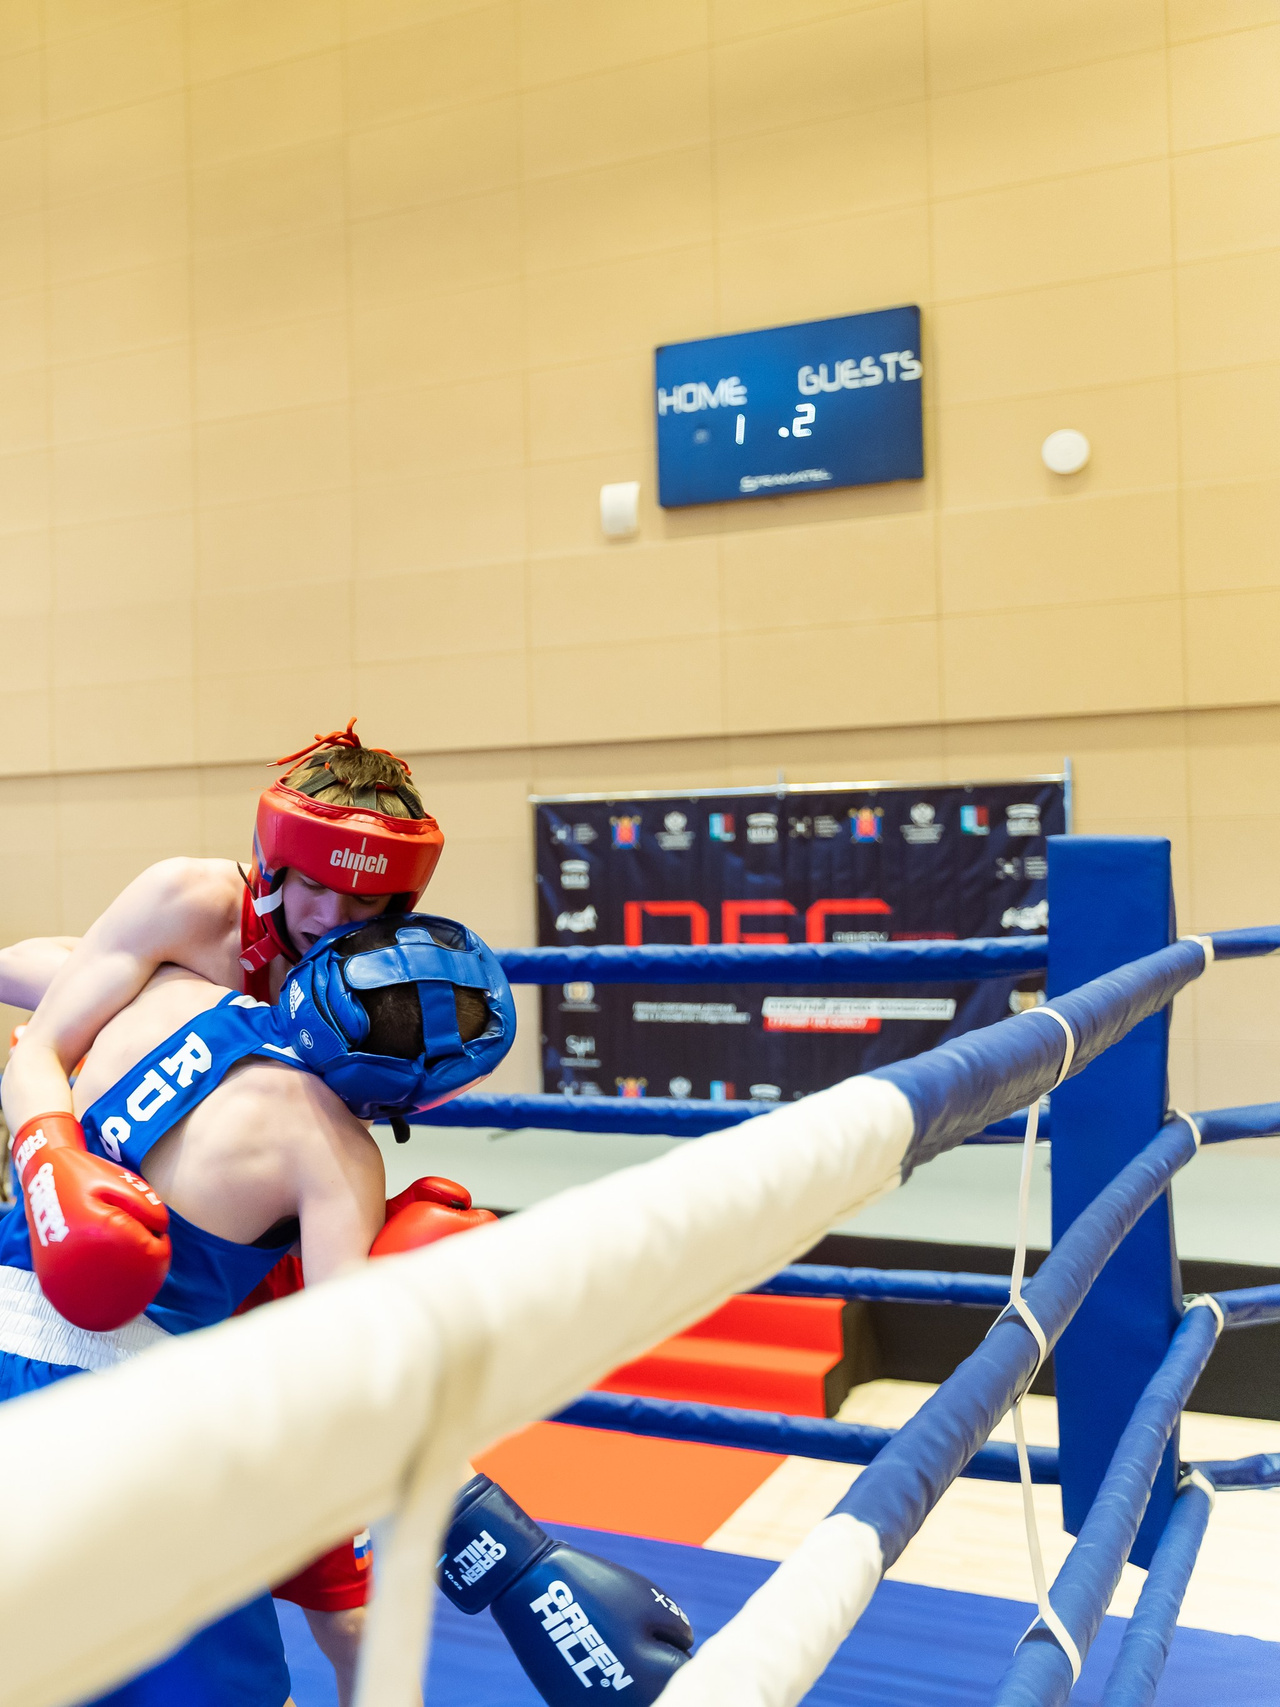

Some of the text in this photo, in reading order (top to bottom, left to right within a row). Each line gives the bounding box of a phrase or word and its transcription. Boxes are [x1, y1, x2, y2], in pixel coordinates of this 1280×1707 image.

[658, 375, 748, 416] HOME
[797, 350, 923, 396] GUESTS
[329, 847, 389, 875] clinch
[453, 1529, 498, 1571] HILL
[461, 1542, 507, 1587] GREEN
[529, 1591, 598, 1689] HILL
[547, 1579, 635, 1692] GREEN
